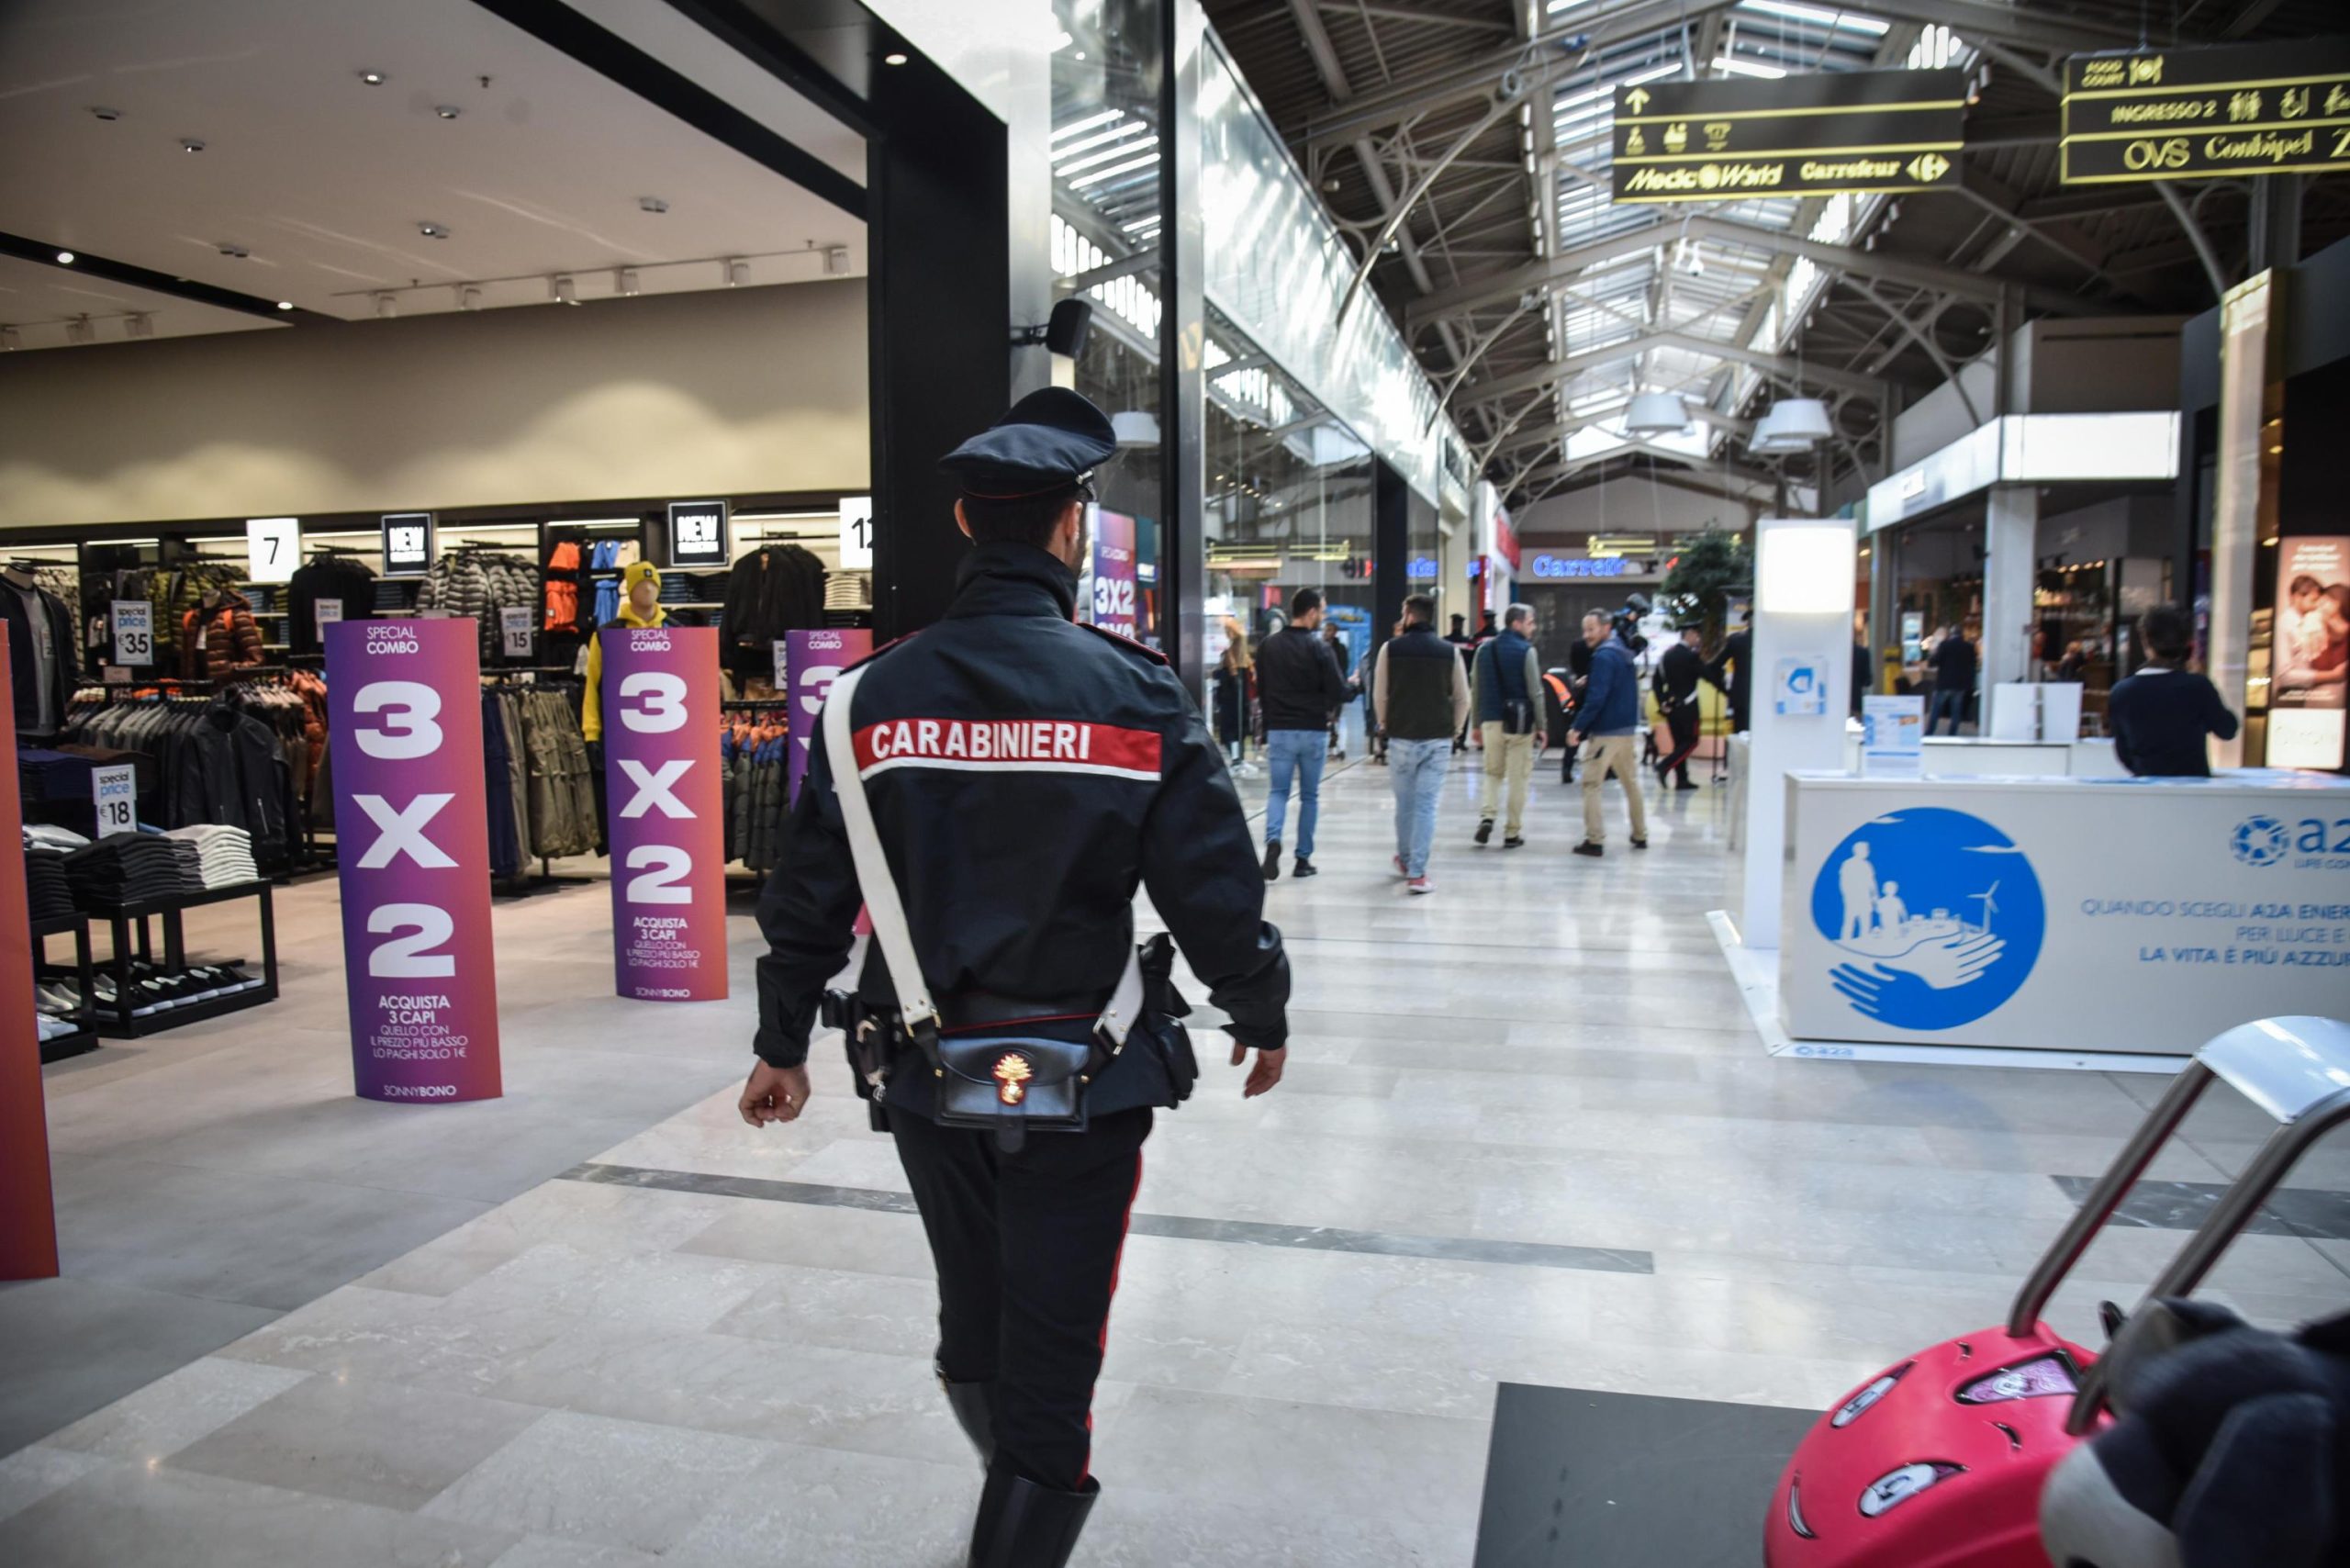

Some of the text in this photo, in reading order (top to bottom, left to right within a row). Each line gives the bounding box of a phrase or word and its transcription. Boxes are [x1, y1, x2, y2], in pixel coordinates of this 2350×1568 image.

[2112, 99, 2217, 123] INGRESSO 2
[2124, 138, 2190, 170] OVS
[1800, 159, 1901, 180] Carrefour
[263, 537, 279, 565] 7
[1095, 577, 1135, 615] 3X2
[118, 617, 147, 629] price
[367, 626, 417, 639] SPECIAL
[632, 630, 669, 640] SPECIAL
[367, 641, 419, 654] COMBO
[631, 642, 671, 652] COMBO
[871, 720, 1091, 759] CARABINIERI
[101, 783, 129, 799] price
[2081, 899, 2175, 916] QUANDO
[2179, 902, 2247, 918] SCEGLI
[2251, 903, 2292, 918] A2A
[633, 916, 688, 929] ACQUISTA
[641, 929, 677, 940] 3 CAPI
[2237, 926, 2344, 944] PER LUCE E
[2139, 946, 2166, 961] LA
[2172, 947, 2218, 962] VITA
[378, 995, 451, 1010] ACQUISTA
[389, 1011, 435, 1025] 3 CAPI
[380, 1025, 449, 1036] QUELLO CON
[377, 1036, 411, 1047] PREZZO
[431, 1035, 468, 1047] BASSO
[373, 1047, 386, 1058] LO
[386, 1048, 418, 1059] PAGHI
[420, 1047, 451, 1059] SOLO
